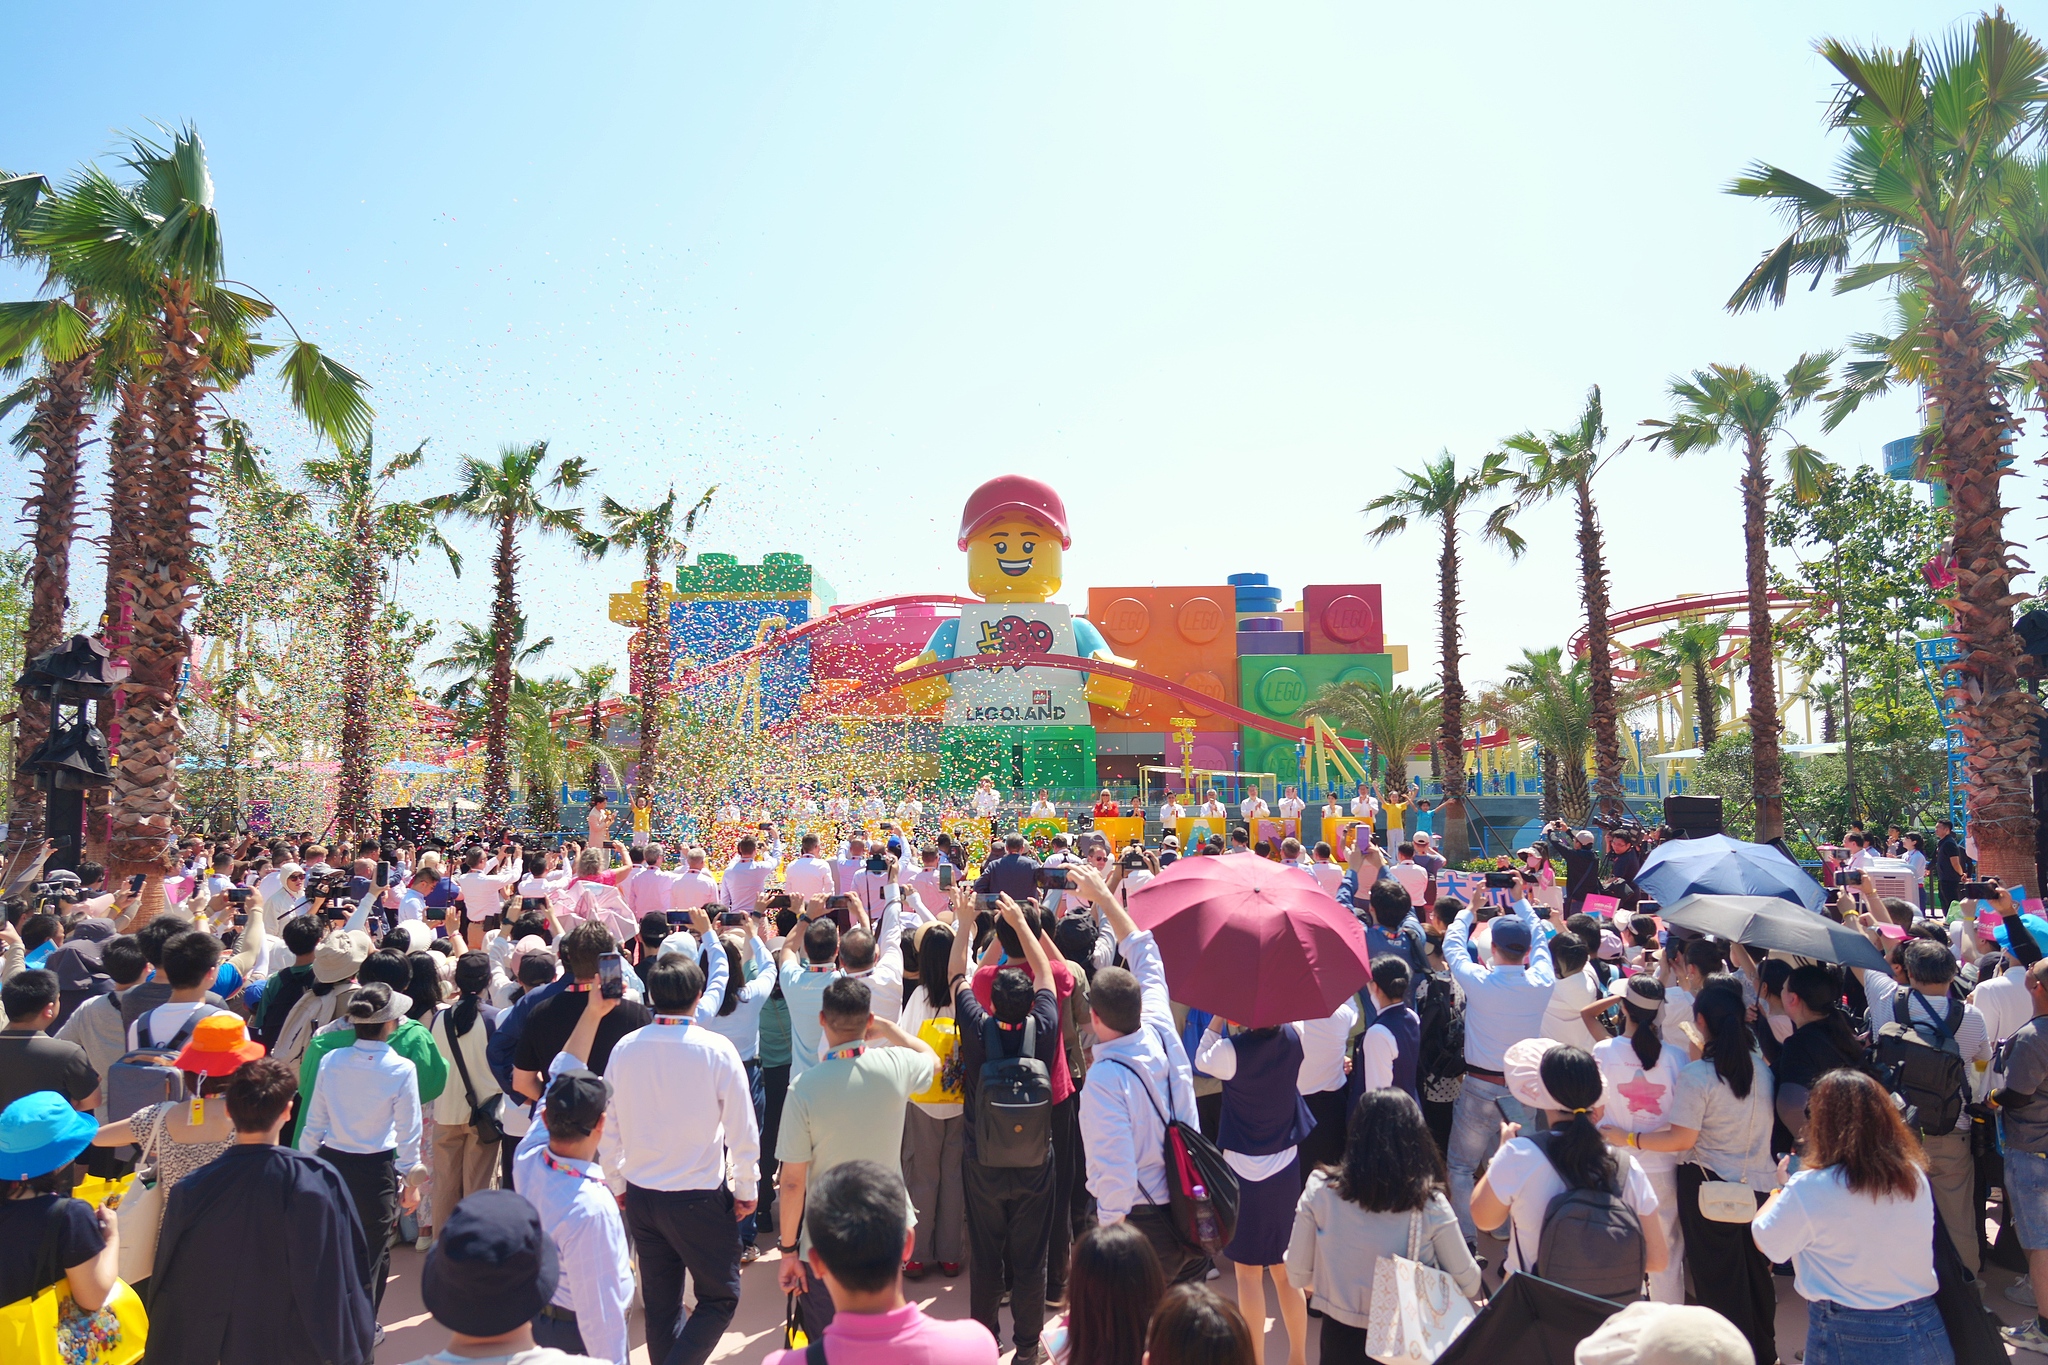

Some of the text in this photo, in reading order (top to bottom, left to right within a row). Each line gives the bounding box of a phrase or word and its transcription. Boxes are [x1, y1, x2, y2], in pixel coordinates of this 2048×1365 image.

[1110, 611, 1144, 631] LEGO
[1184, 611, 1219, 630] LEGO
[1332, 609, 1368, 629] LEGO
[1265, 681, 1302, 702] LEGO
[966, 690, 1066, 721] LEGOLAND
[1183, 818, 1216, 857] A
